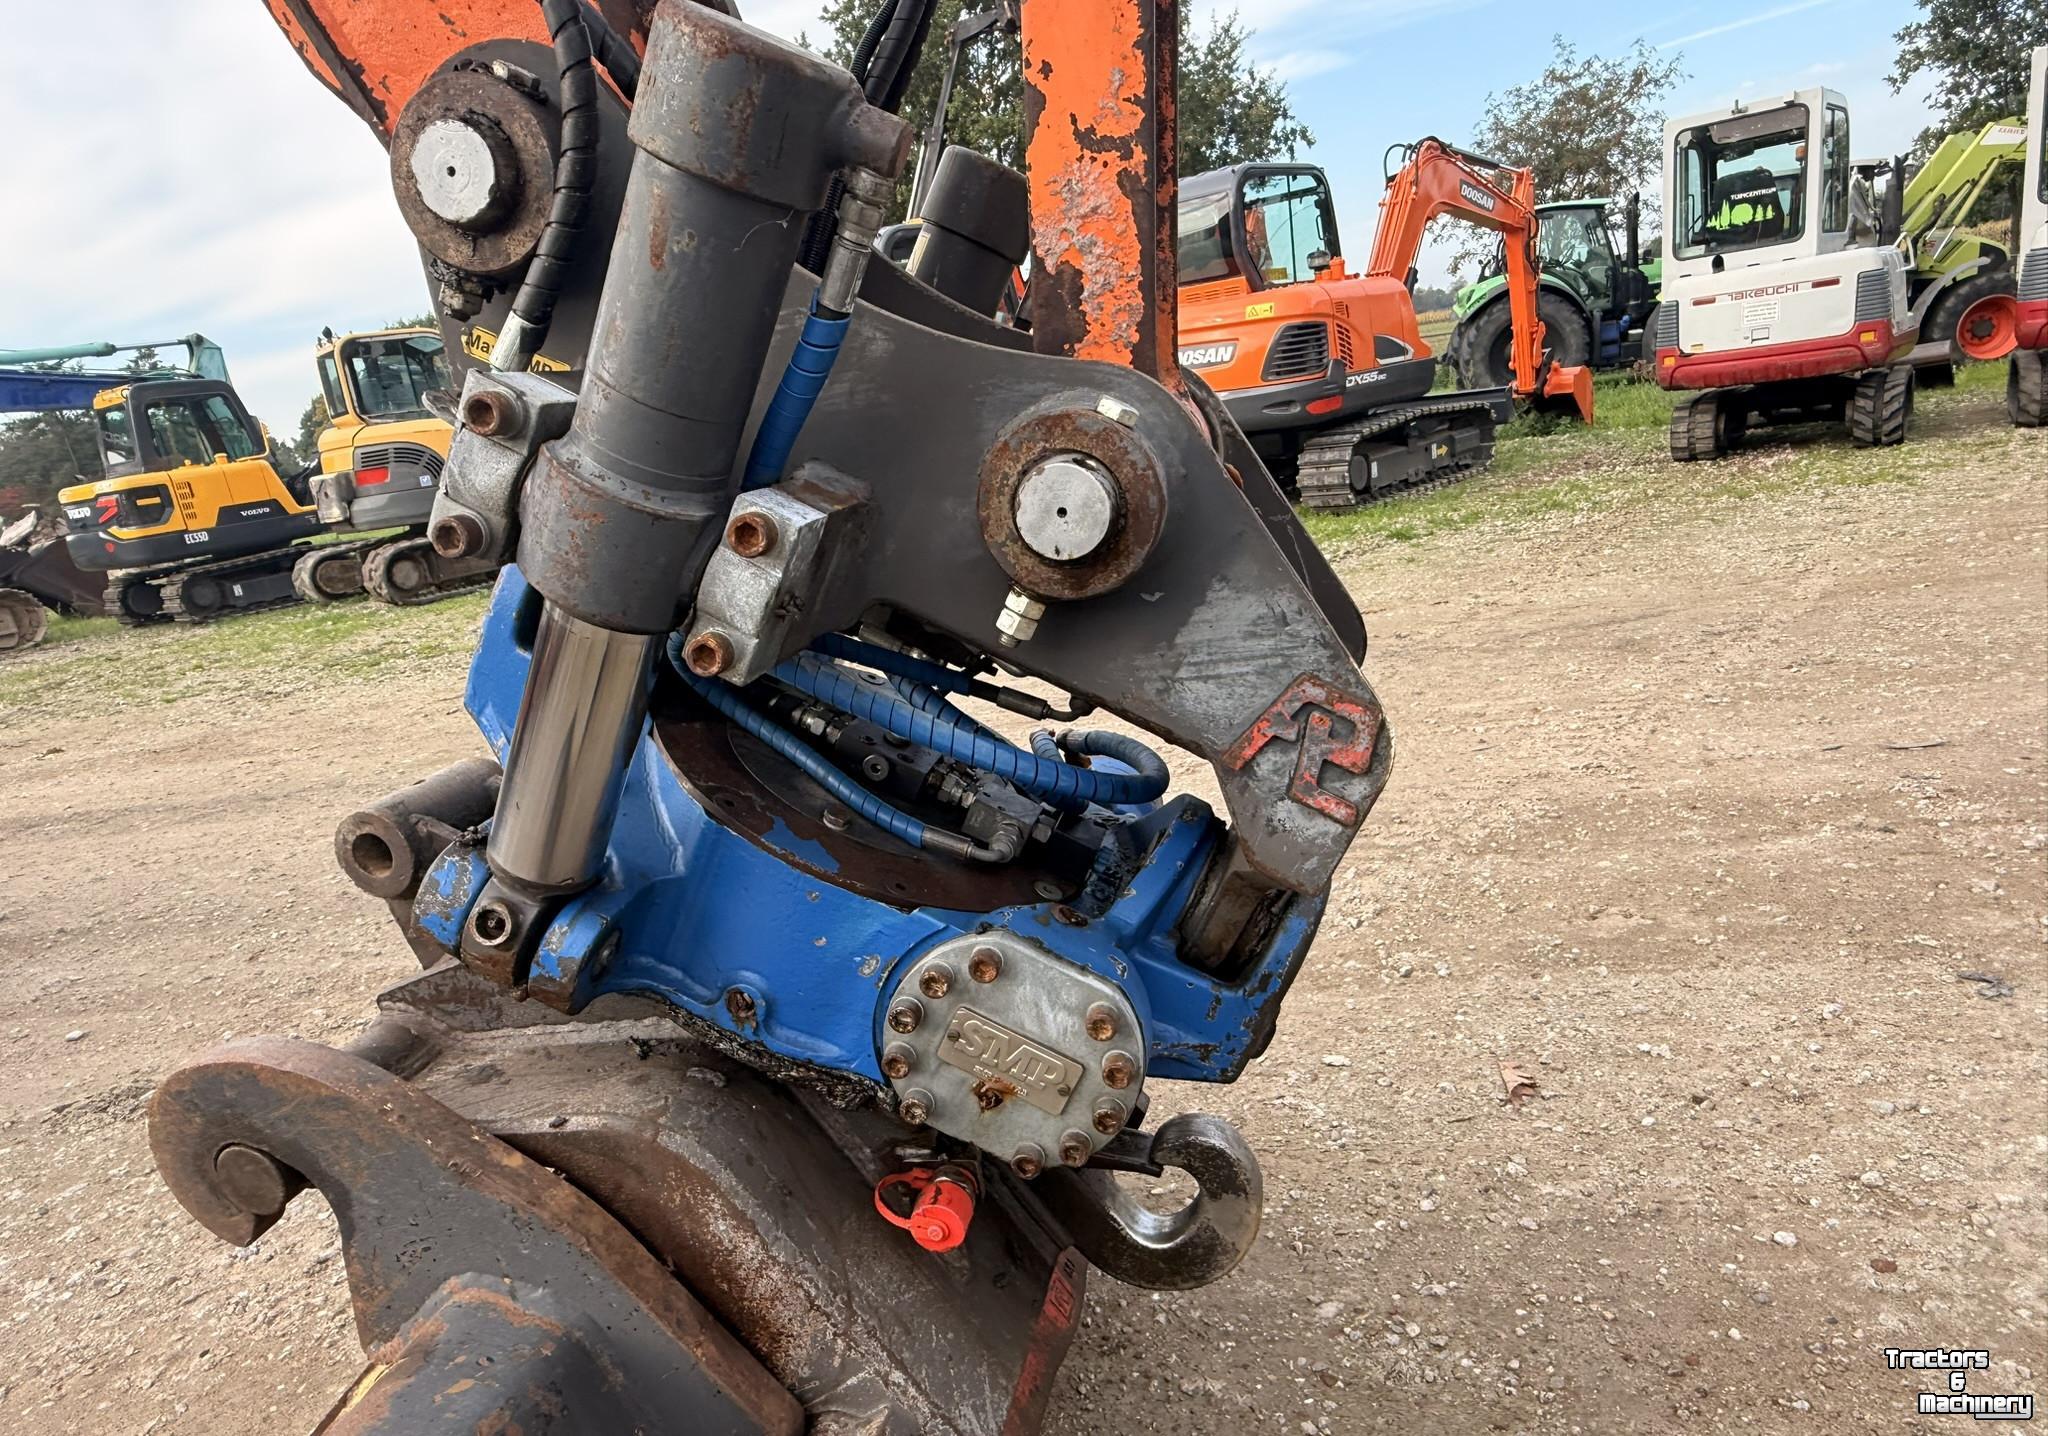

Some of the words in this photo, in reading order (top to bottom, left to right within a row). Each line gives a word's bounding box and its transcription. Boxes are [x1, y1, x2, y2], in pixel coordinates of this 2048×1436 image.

[1461, 183, 1494, 211] DOOSAN
[240, 507, 270, 516] VOLVO
[955, 1020, 1066, 1090] SMP
